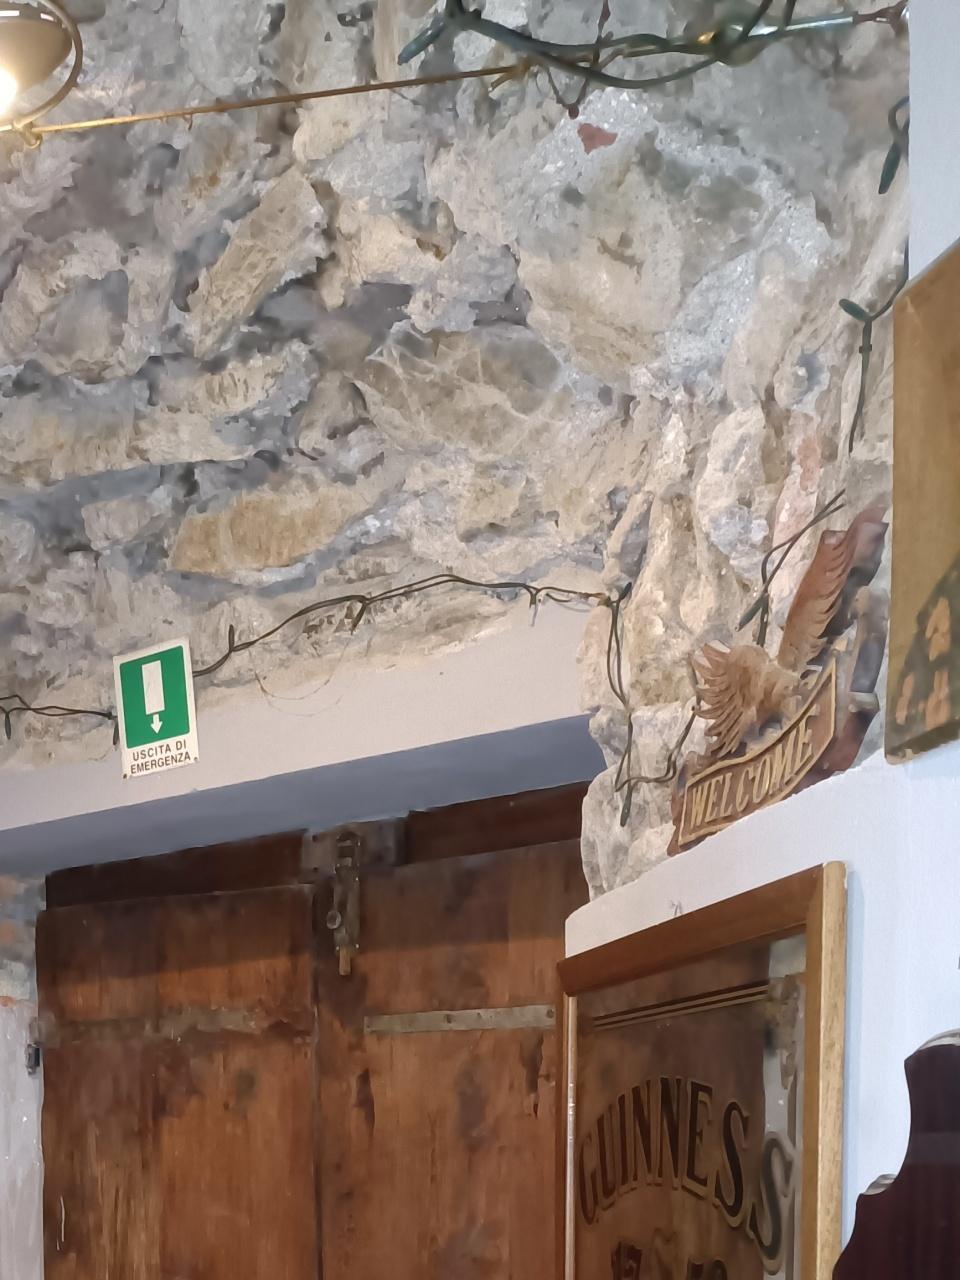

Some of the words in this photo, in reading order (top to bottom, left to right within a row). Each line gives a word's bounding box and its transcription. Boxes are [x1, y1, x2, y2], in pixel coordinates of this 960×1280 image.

[130, 751, 191, 774] EMERGENZA
[132, 744, 172, 762] USCITA
[175, 739, 187, 751] DI
[690, 703, 819, 829] WELCOME
[578, 1075, 796, 1276] GUINNESS
